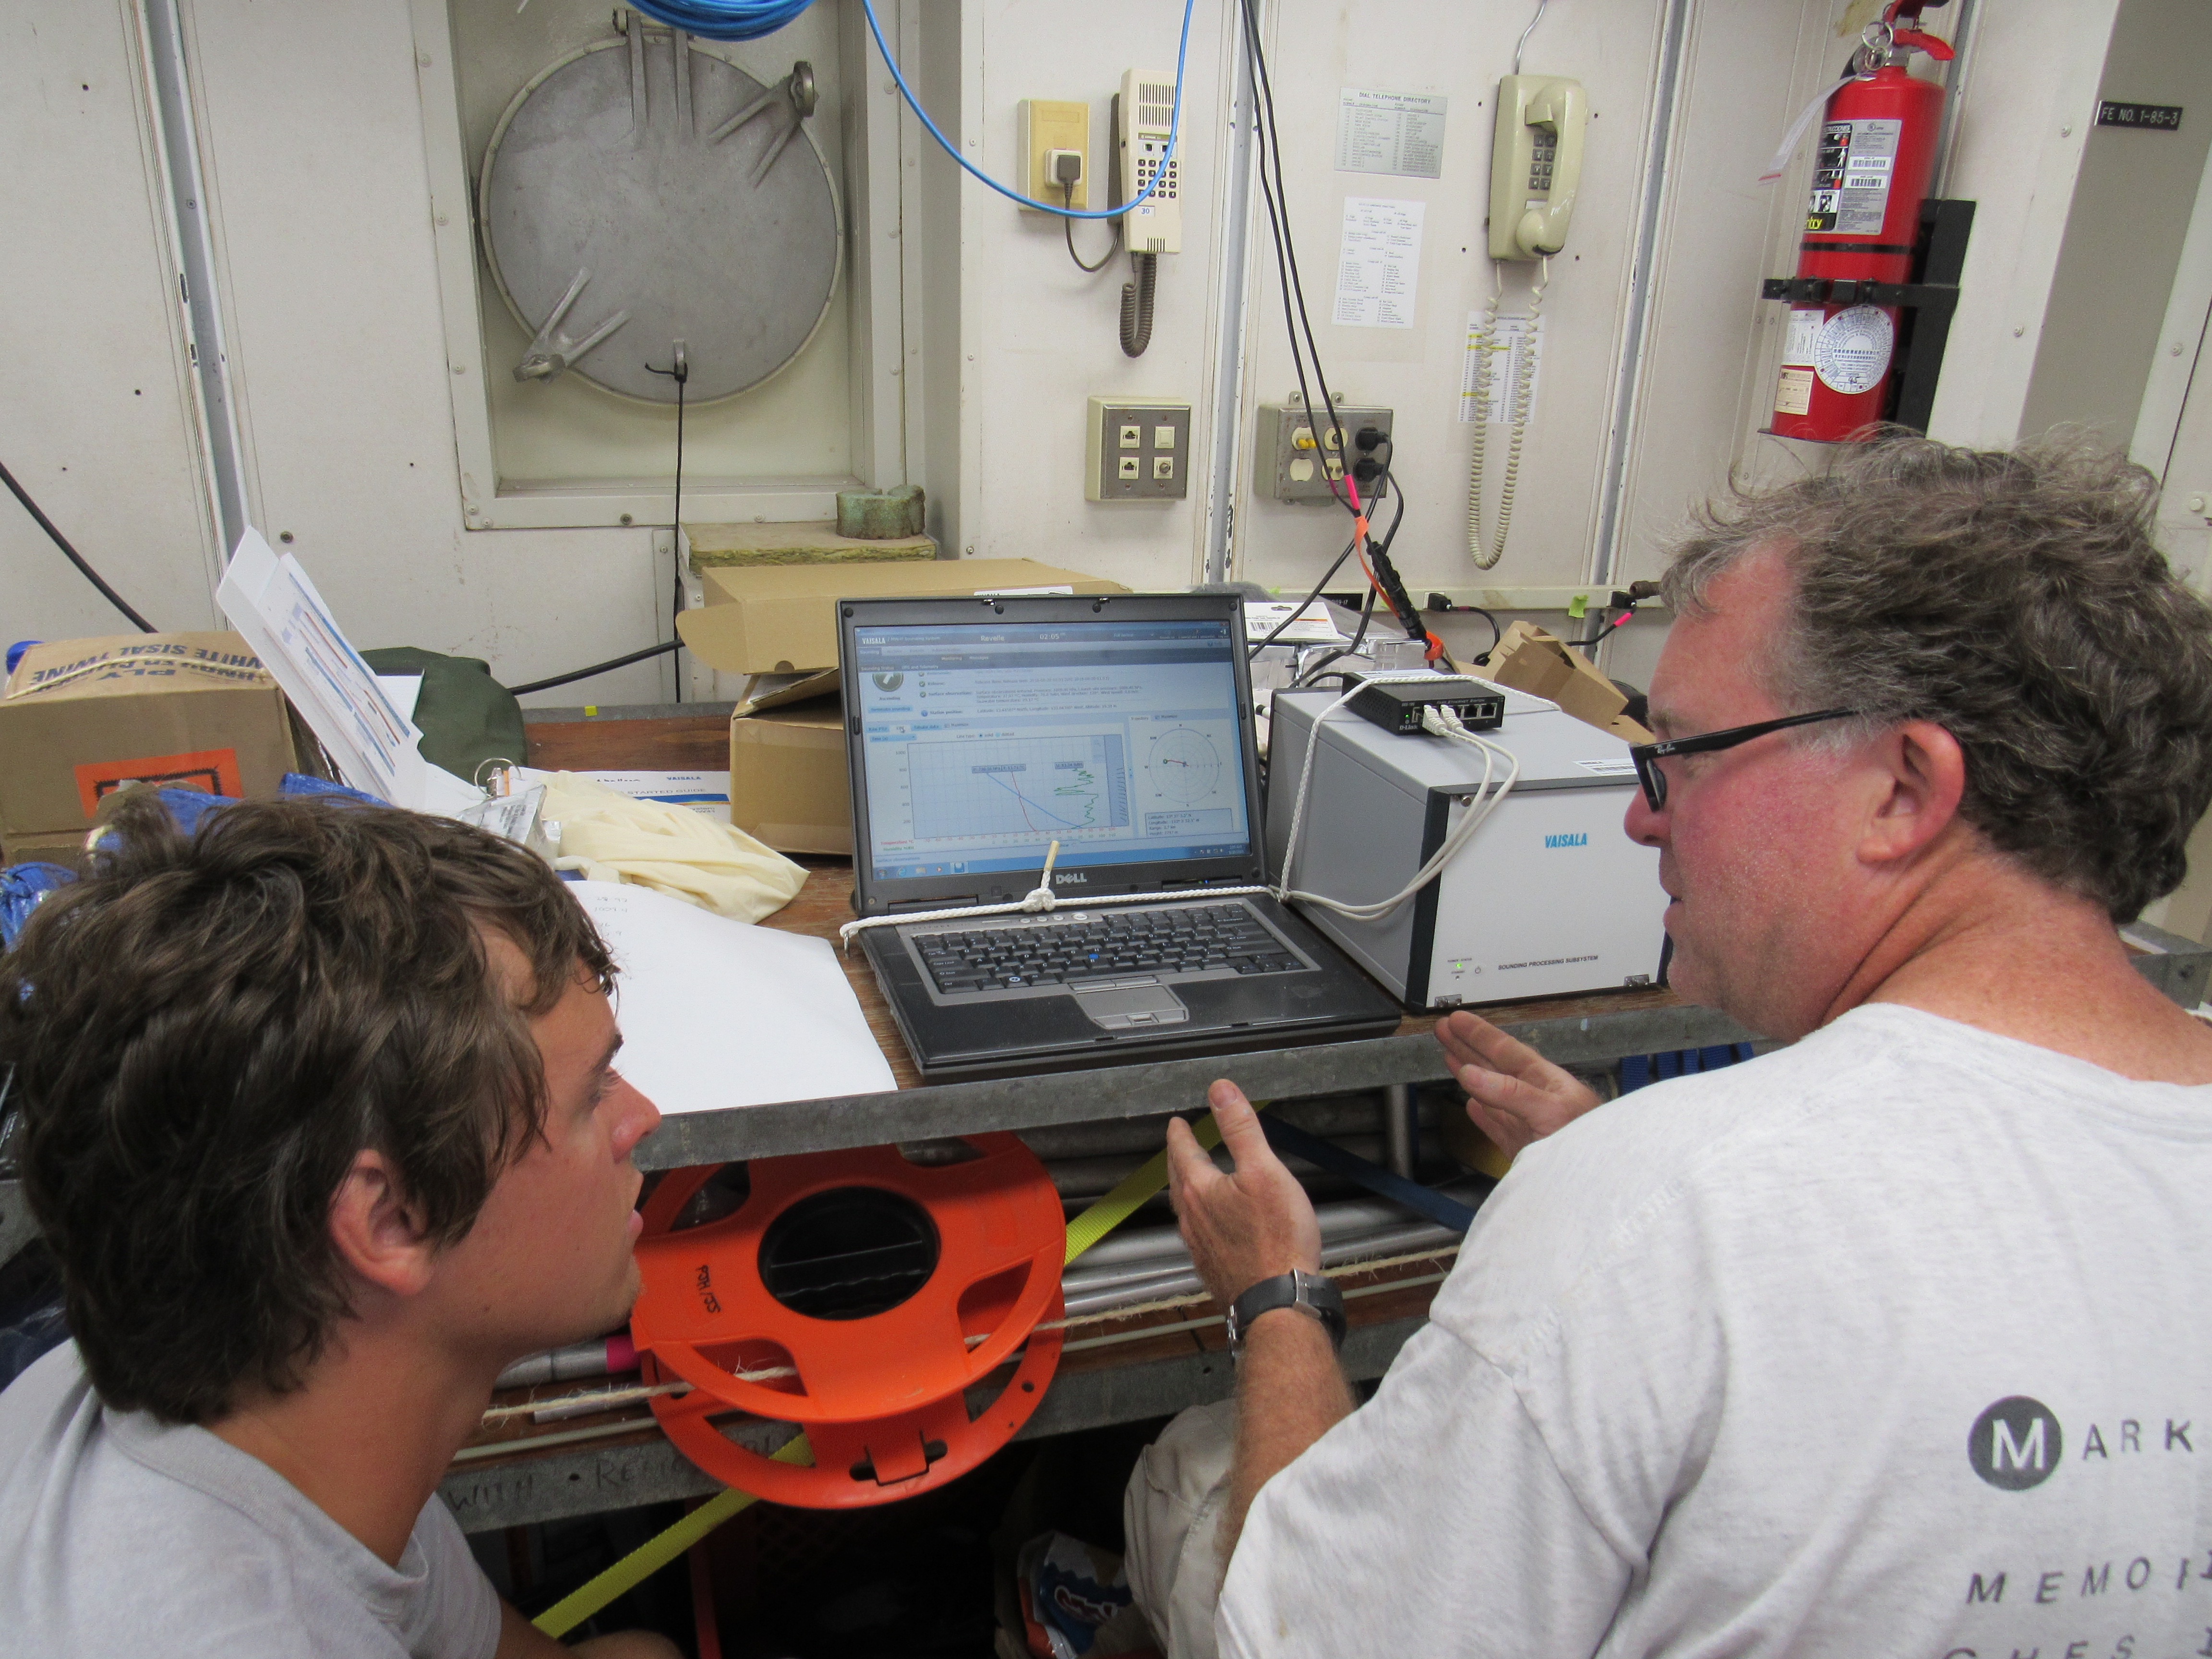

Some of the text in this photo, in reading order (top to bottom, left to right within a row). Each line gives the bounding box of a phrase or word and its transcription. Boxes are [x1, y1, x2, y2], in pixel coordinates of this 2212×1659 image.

[1372, 94, 1402, 102] TELEPHONE
[2101, 107, 2179, 125] FE NO. 1-85-3
[120, 644, 189, 656] SISAL
[97, 669, 177, 681] PLY
[1545, 833, 1587, 848] VAISALA
[1056, 872, 1088, 885] DELL
[1528, 958, 1564, 967] PROCESSING
[1565, 955, 1599, 963] SUBSYSTEM
